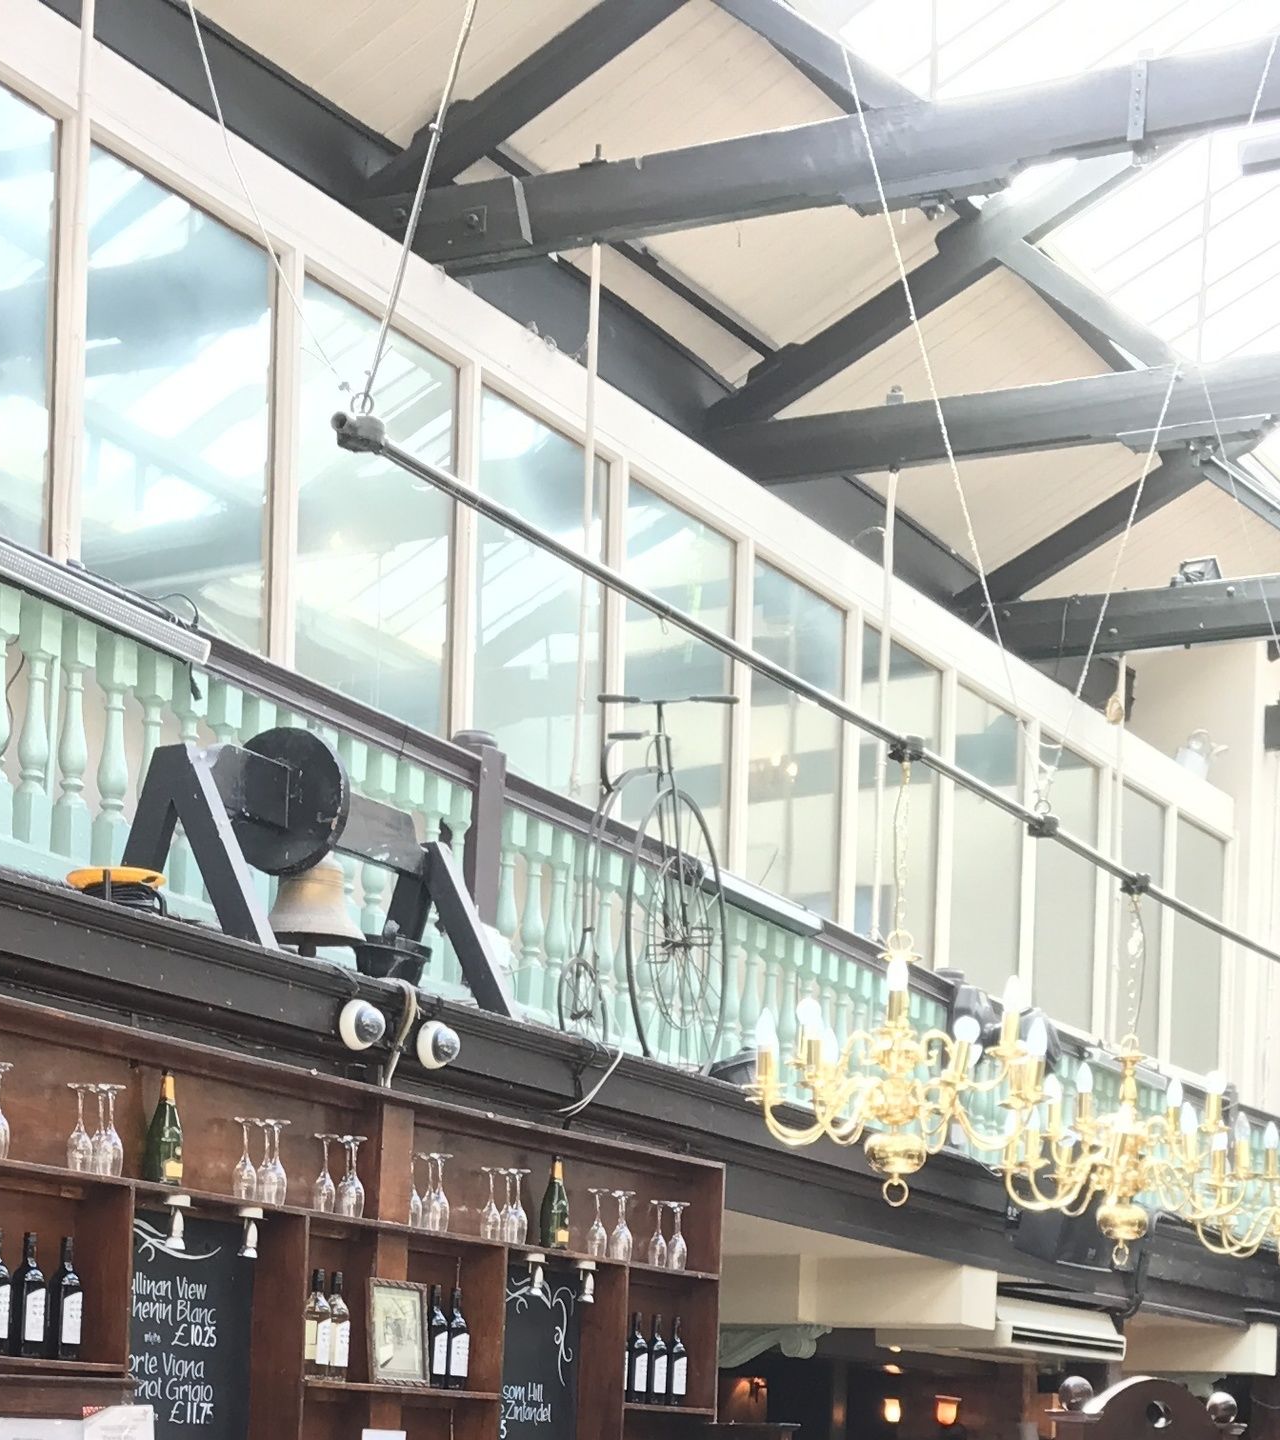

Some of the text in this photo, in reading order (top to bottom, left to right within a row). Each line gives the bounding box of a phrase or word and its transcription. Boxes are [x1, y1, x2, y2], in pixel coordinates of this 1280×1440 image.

[175, 1275, 207, 1301] View
[176, 1299, 217, 1325] Blanc
[162, 1352, 205, 1382] Vigna
[165, 1377, 214, 1403] Grigio
[527, 1381, 544, 1403] Hill
